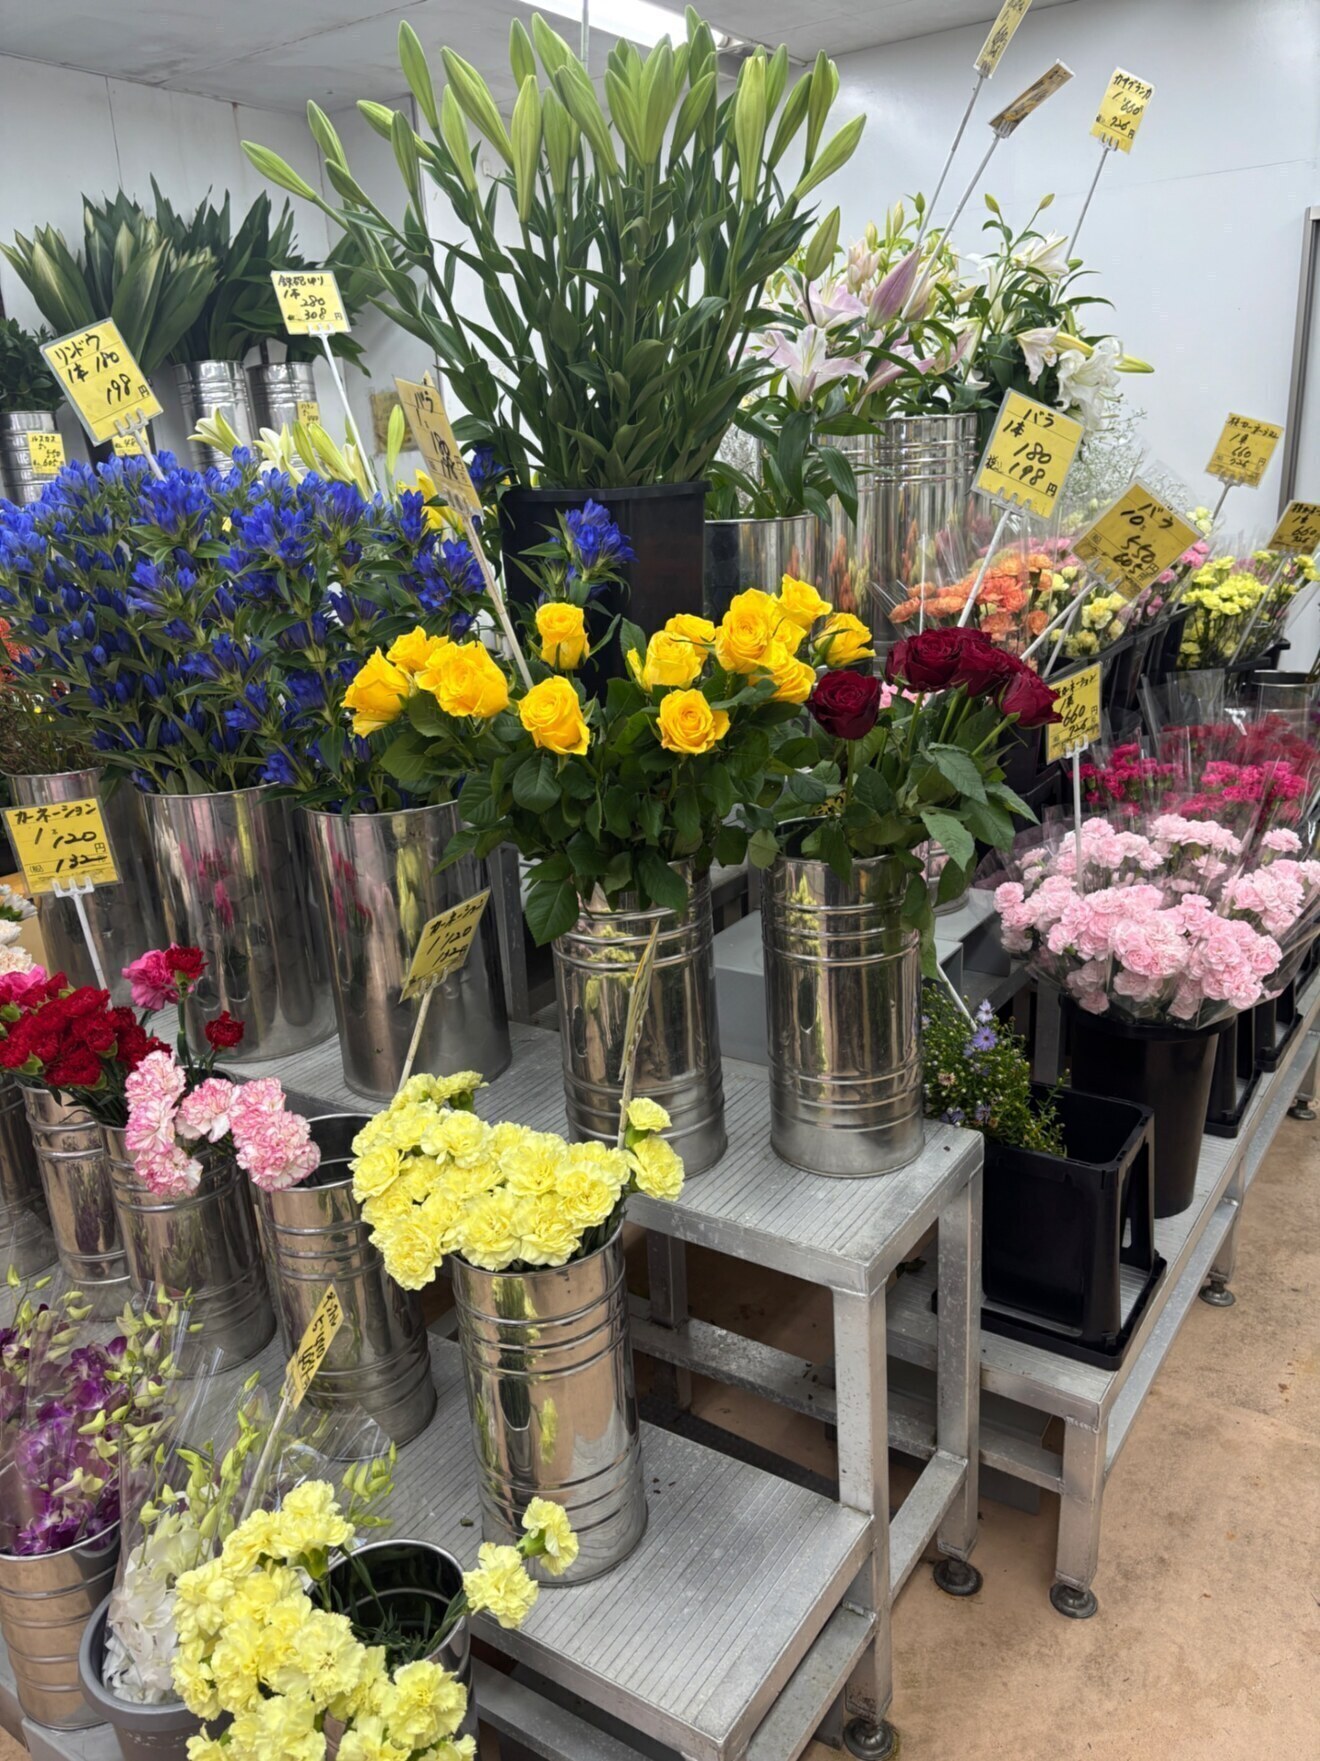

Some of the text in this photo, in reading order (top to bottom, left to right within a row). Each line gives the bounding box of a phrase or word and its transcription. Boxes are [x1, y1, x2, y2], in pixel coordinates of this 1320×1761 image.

[300, 295, 326, 307] 280
[305, 307, 327, 320] 308
[54, 333, 100, 365] リンドウ
[107, 373, 150, 405] 198 円
[1023, 408, 1055, 428] バラ
[1013, 442, 1052, 464] 180
[1008, 462, 1046, 486] 198
[1045, 482, 1058, 497] 円
[1138, 503, 1174, 529] バラ
[14, 803, 97, 825] カーネーション
[52, 831, 97, 849] 120
[94, 842, 106, 853] 円
